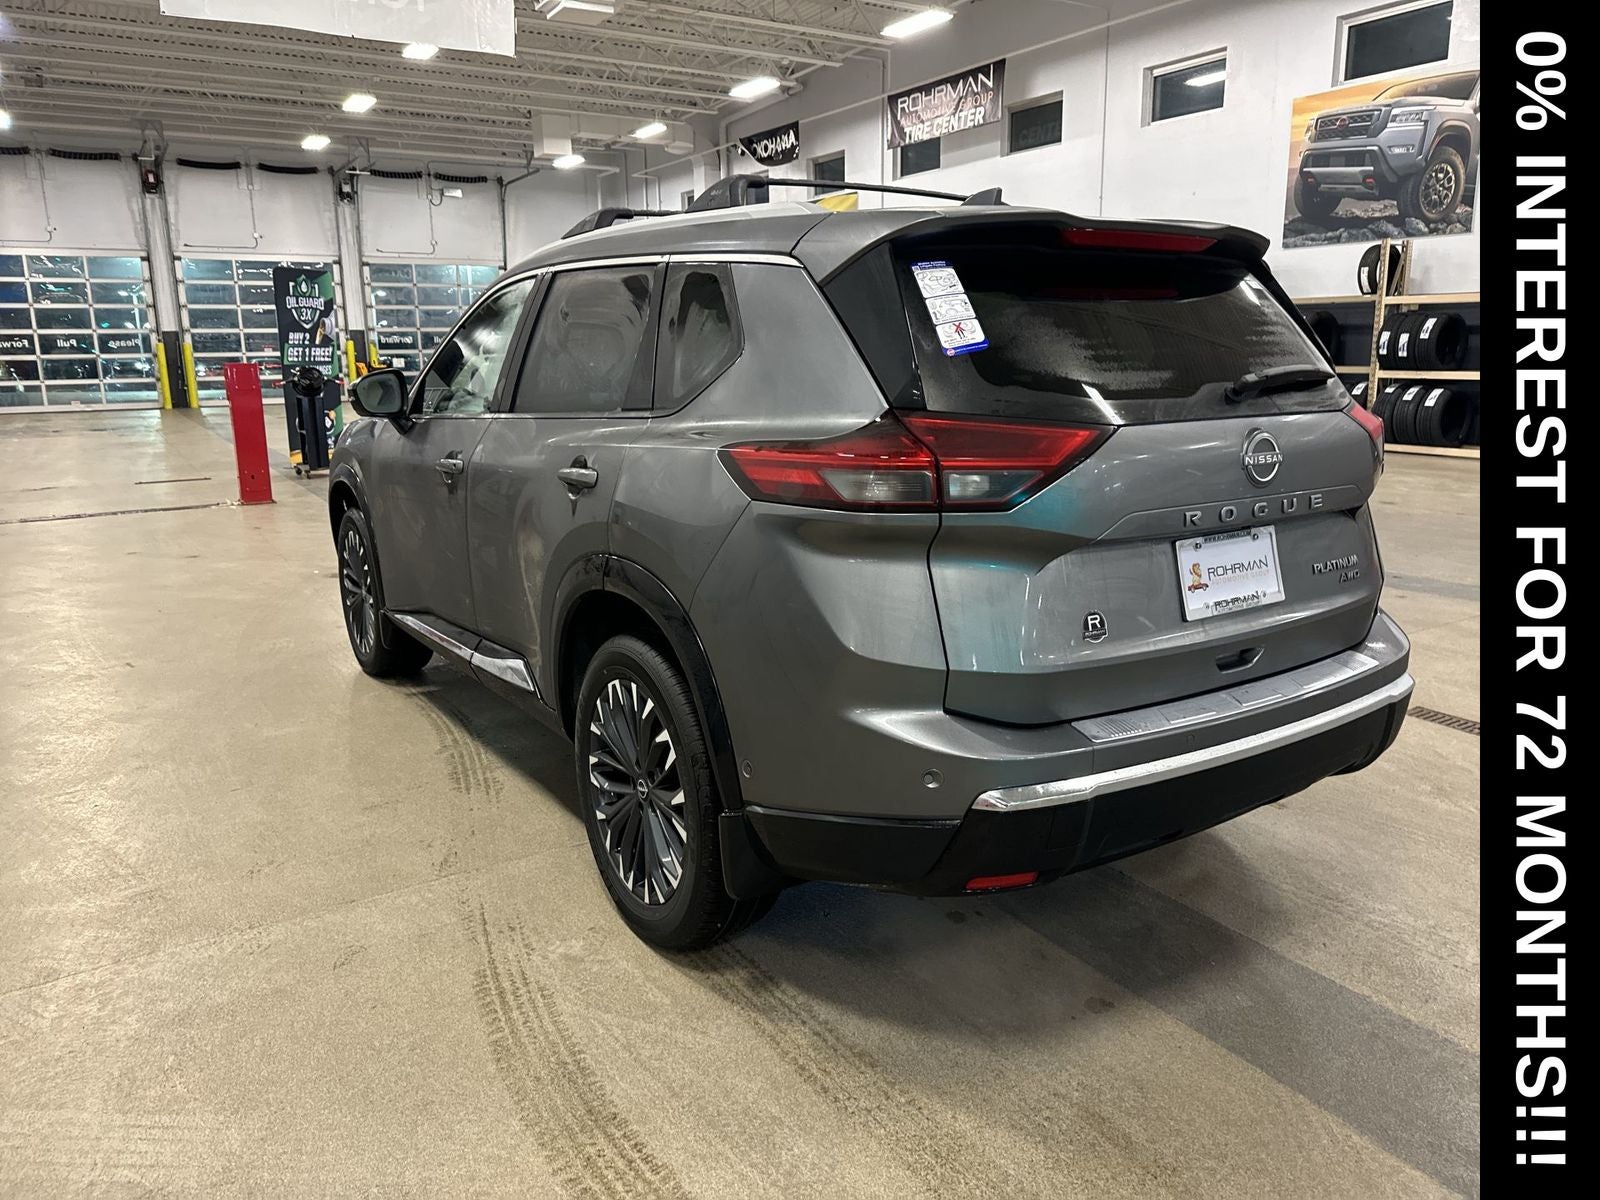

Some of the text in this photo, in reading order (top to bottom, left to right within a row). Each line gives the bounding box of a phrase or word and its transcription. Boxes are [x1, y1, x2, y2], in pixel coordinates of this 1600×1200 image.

[897, 64, 993, 121] ROHRMAN
[960, 91, 994, 111] GROUP
[904, 106, 984, 144] TIRE CENTER
[285, 296, 324, 310] OIL GUARD
[300, 308, 312, 320] 3X
[288, 332, 310, 344] BUY 2
[287, 345, 333, 361] GET 1 FREE!
[1244, 453, 1283, 465] NISSAN
[1184, 494, 1323, 527] ROGUE
[1207, 555, 1268, 581] ROHRMAN
[1312, 554, 1358, 575] PLATINUM
[1339, 569, 1360, 583] AWD
[1213, 590, 1260, 611] ROHRMAN
[1087, 614, 1101, 631] R
